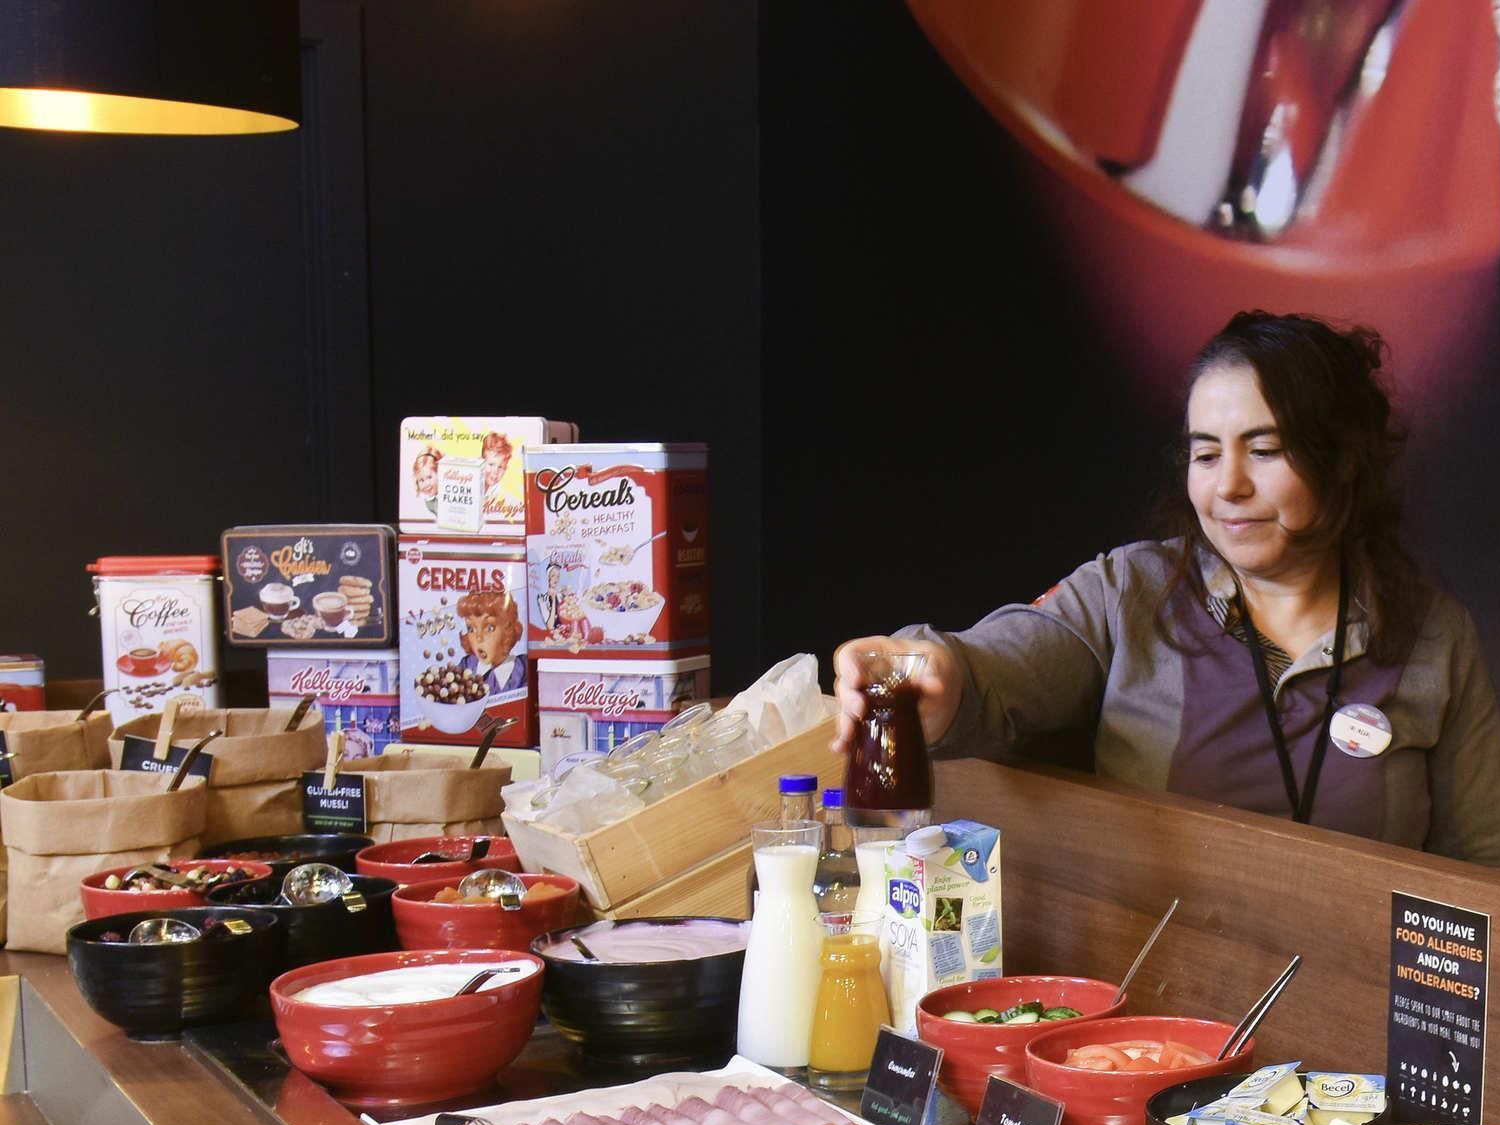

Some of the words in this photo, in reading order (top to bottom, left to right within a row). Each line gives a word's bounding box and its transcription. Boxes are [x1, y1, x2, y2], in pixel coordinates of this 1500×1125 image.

[443, 494, 474, 506] FLAKES
[444, 484, 472, 494] CORN
[535, 466, 636, 517] Cereals
[581, 521, 636, 538] BREAKFAST
[592, 510, 635, 524] HEALTHY
[416, 566, 506, 594] CEREALS
[122, 598, 192, 630] Coffee
[290, 665, 365, 700] Kellogg's
[563, 680, 639, 715] Kellogg's
[320, 798, 349, 810] MUESLI
[891, 882, 920, 909] alpro
[889, 920, 919, 953] SOYA
[1404, 910, 1420, 926] DO
[1421, 914, 1444, 933] YOU
[1446, 921, 1476, 942] HAVE
[1396, 927, 1425, 946] FOOD
[1427, 936, 1483, 963] ALLERGIES
[1417, 952, 1460, 976] AND/OR
[1397, 964, 1480, 1001] INTOLERANCES?
[1320, 1080, 1351, 1093] Becel
